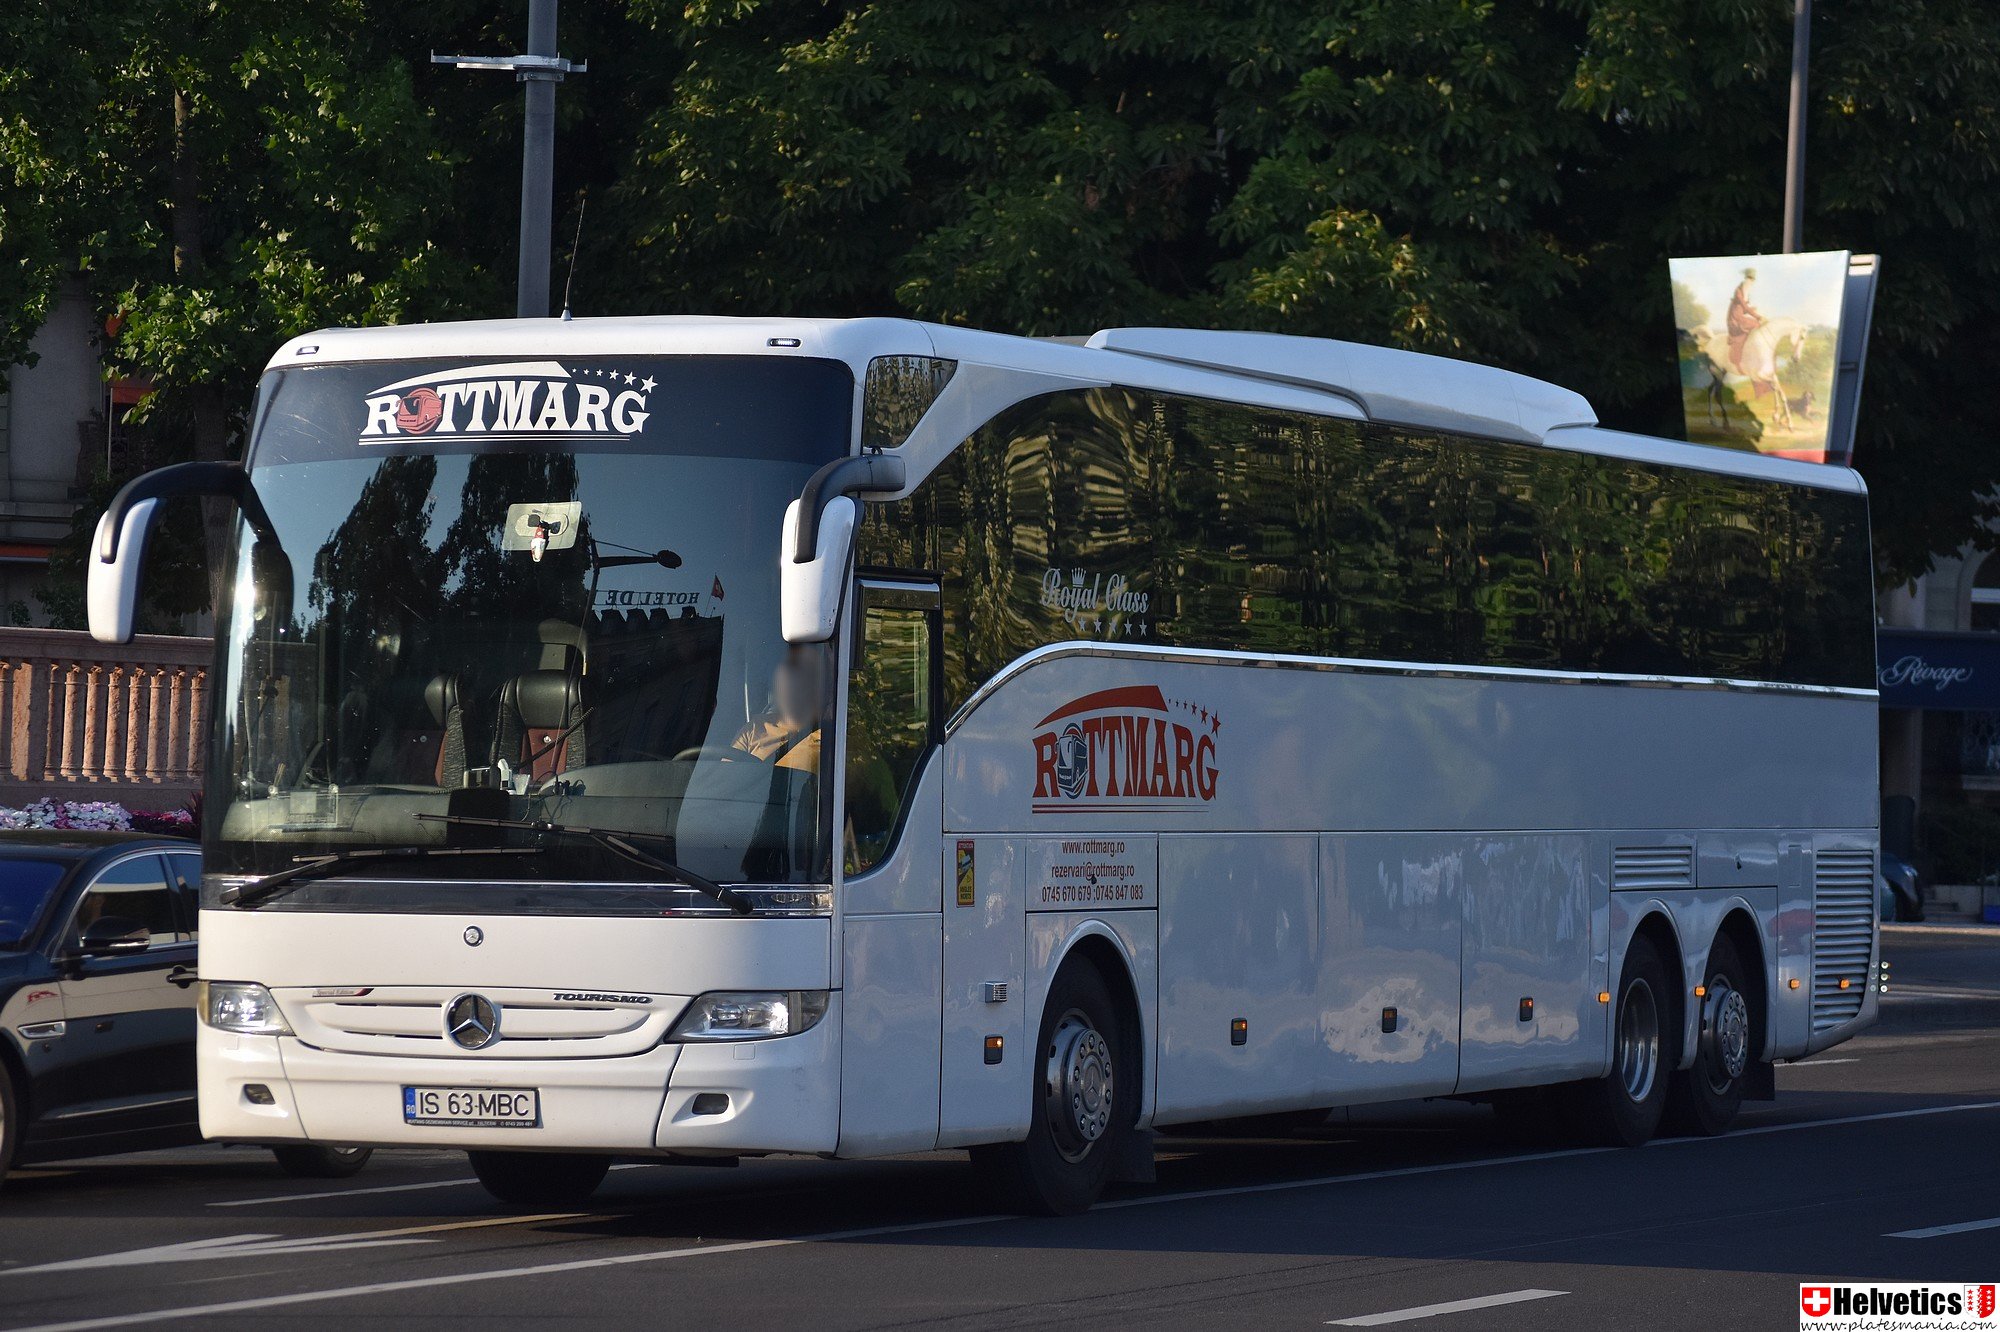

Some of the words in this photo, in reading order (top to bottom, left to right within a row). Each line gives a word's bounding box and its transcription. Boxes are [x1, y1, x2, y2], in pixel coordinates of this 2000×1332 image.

[360, 380, 650, 435] ROTTMARG
[1041, 568, 1100, 623] Royal
[1105, 573, 1149, 614] Class
[1032, 715, 1219, 801] ROTTMARG
[1062, 839, 1125, 857] www.rottmarg.ro
[1051, 862, 1135, 881] rezervari@rottmarg.ro
[1042, 886, 1061, 902] 0745
[1062, 886, 1076, 902] 670
[1078, 885, 1092, 901] 679
[1115, 885, 1128, 901] 847
[1130, 884, 1144, 900] 083
[553, 992, 653, 1004] TOURISMO
[405, 1104, 416, 1115] RO
[419, 1092, 440, 1115] IS
